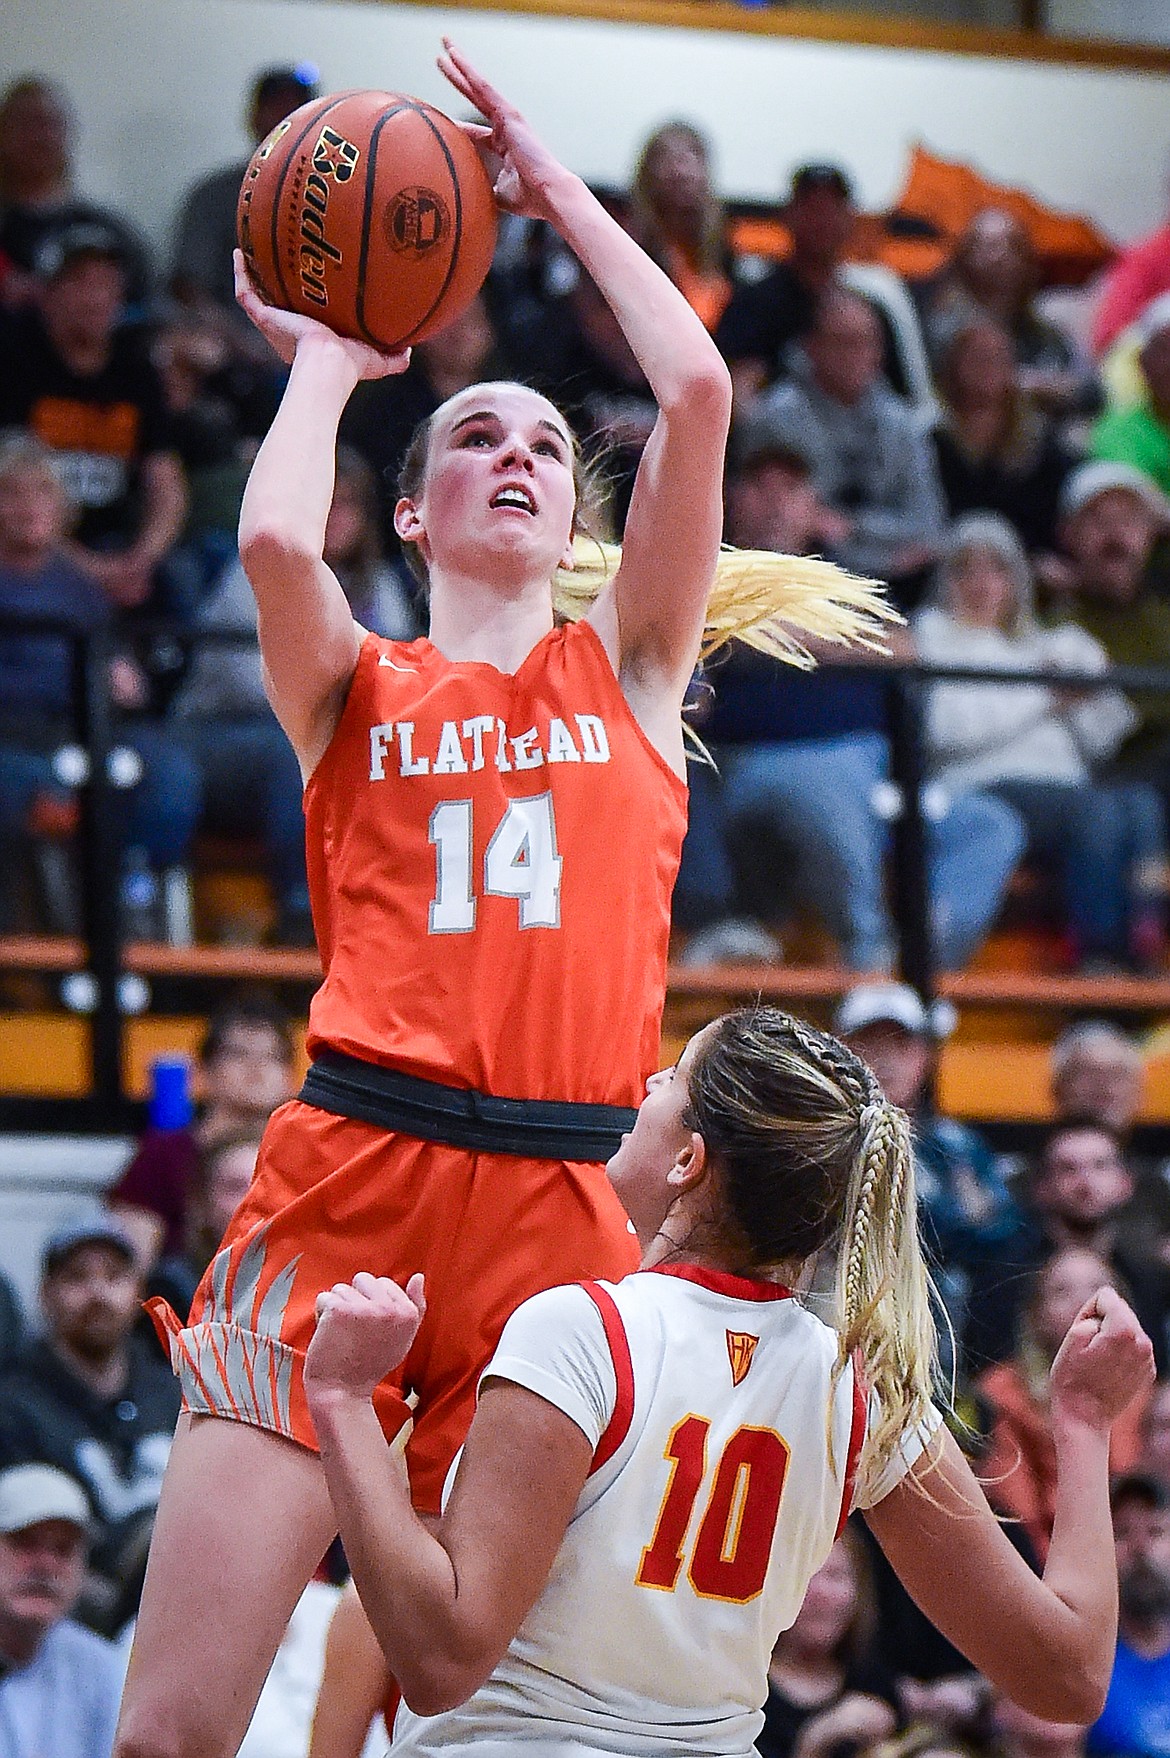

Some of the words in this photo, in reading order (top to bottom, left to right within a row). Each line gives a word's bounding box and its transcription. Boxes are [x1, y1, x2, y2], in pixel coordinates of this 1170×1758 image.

[300, 125, 360, 306] Baden
[428, 790, 563, 935] 14
[634, 1412, 791, 1605] 10
